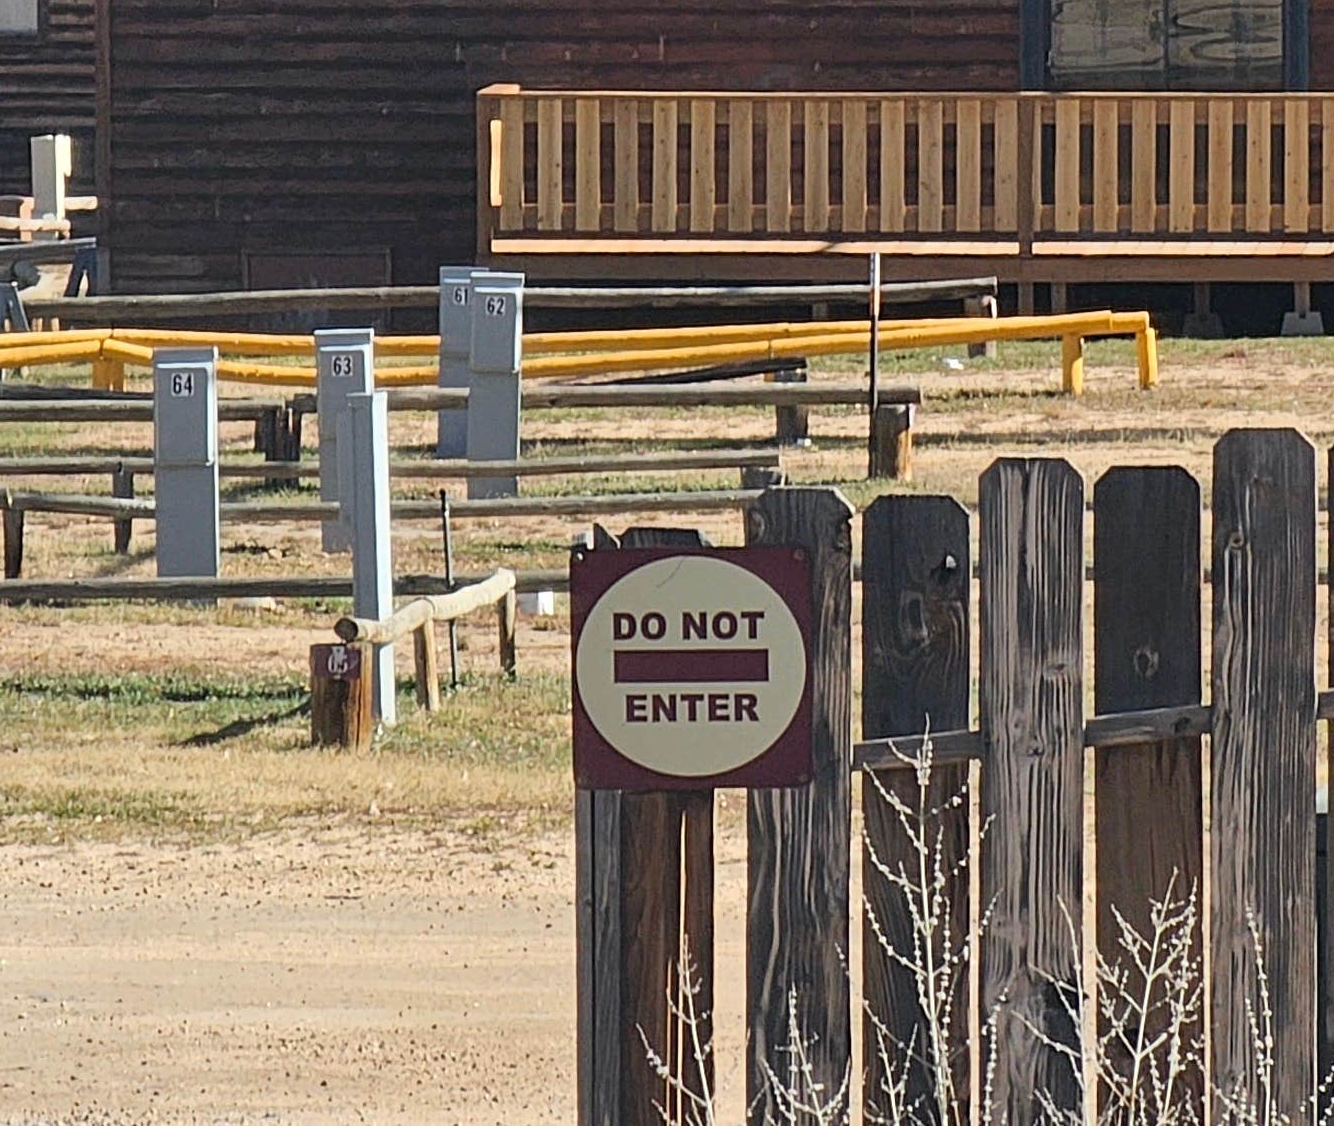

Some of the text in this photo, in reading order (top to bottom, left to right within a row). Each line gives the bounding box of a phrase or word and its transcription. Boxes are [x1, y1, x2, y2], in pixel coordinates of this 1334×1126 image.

[454, 287, 469, 305] 61
[487, 297, 505, 315] 62
[332, 356, 352, 376] 63
[172, 373, 193, 395] 64
[613, 611, 765, 641] DO NOT
[625, 693, 760, 723] ENTER
